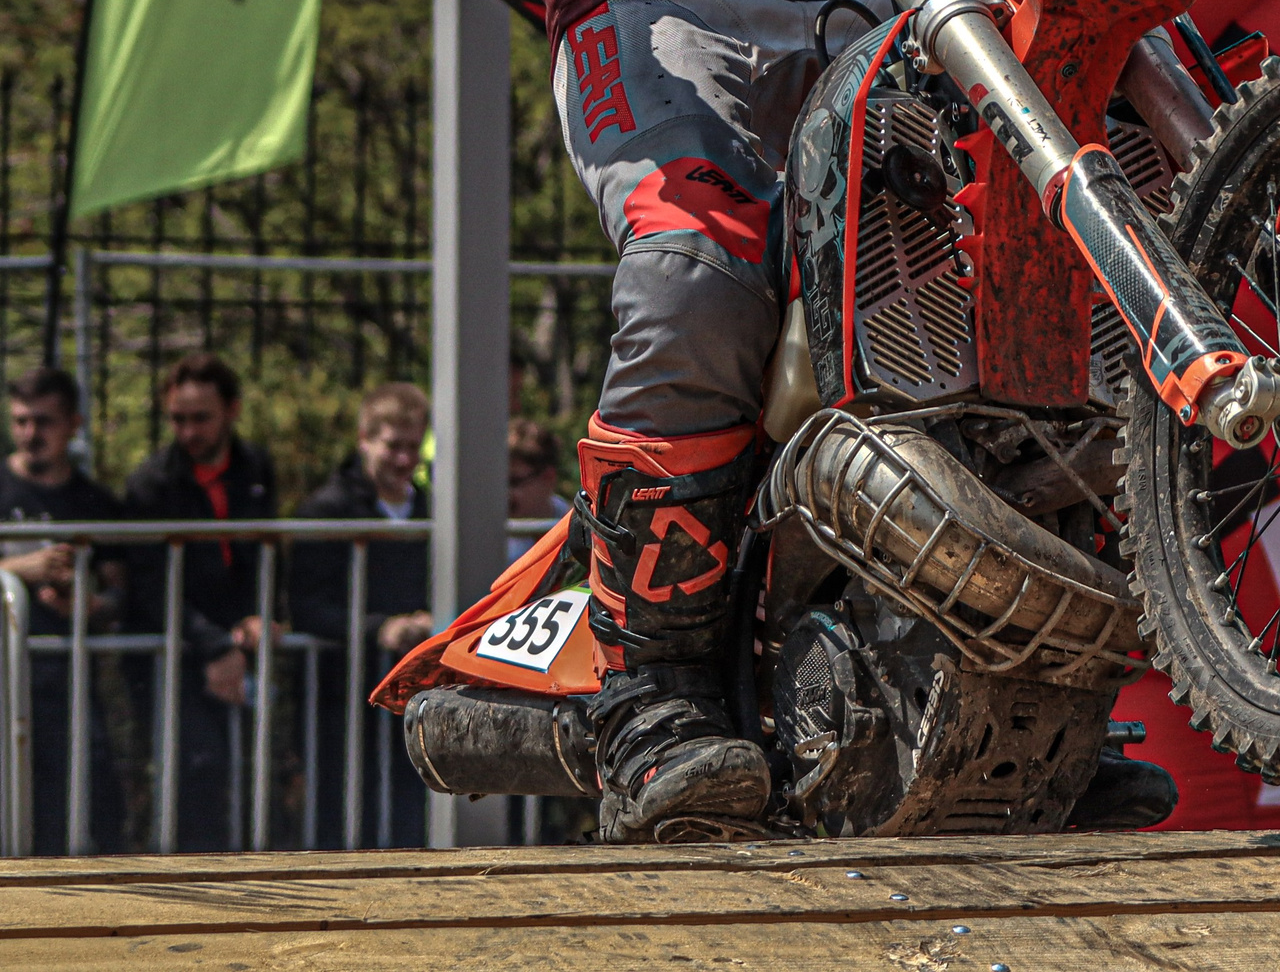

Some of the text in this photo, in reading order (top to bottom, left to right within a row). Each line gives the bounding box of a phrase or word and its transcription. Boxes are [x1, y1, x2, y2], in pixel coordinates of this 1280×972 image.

[685, 164, 758, 205] LEATT
[631, 486, 672, 502] LEATT
[488, 600, 573, 656] 355
